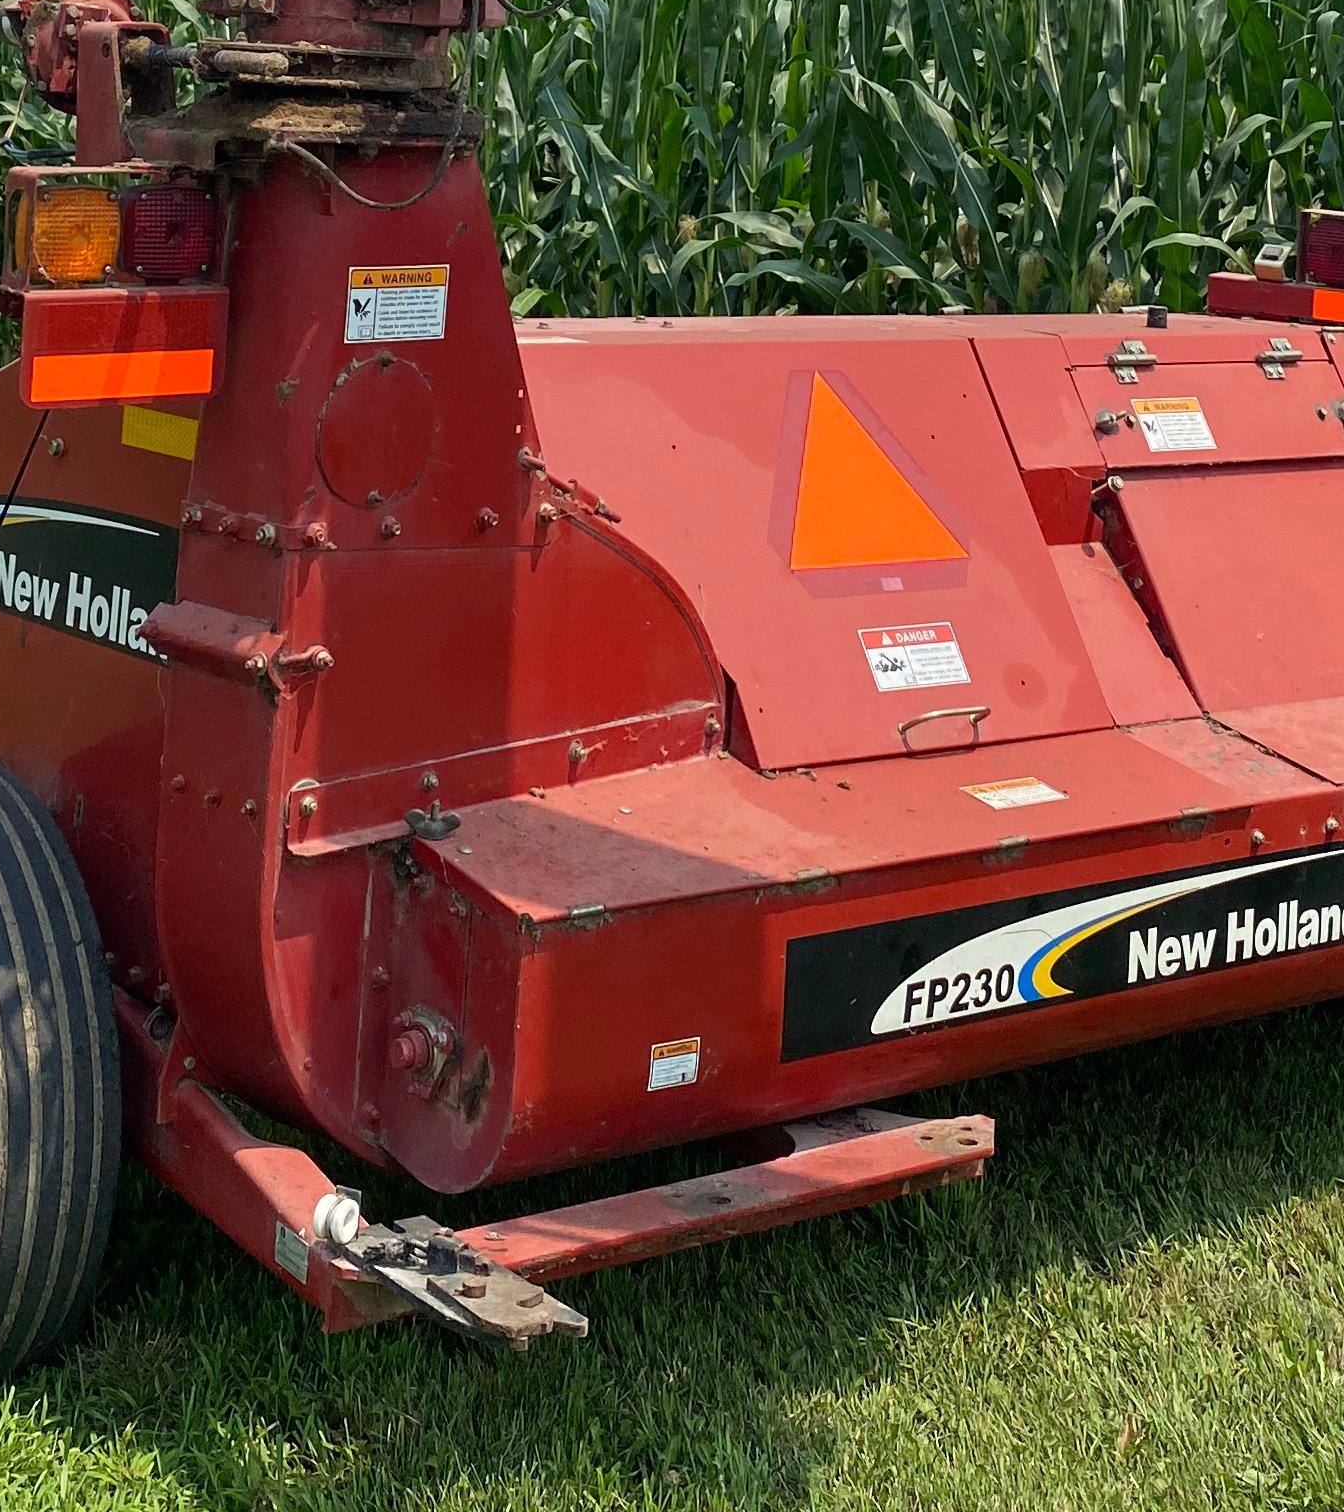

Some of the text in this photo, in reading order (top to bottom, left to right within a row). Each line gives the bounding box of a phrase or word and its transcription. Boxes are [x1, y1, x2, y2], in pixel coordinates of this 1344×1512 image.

[381, 272, 432, 284] WARNING
[65, 571, 168, 660] Holla
[895, 629, 937, 644] DANGER
[902, 963, 1015, 1024] FP230
[1127, 928, 1217, 984] New
